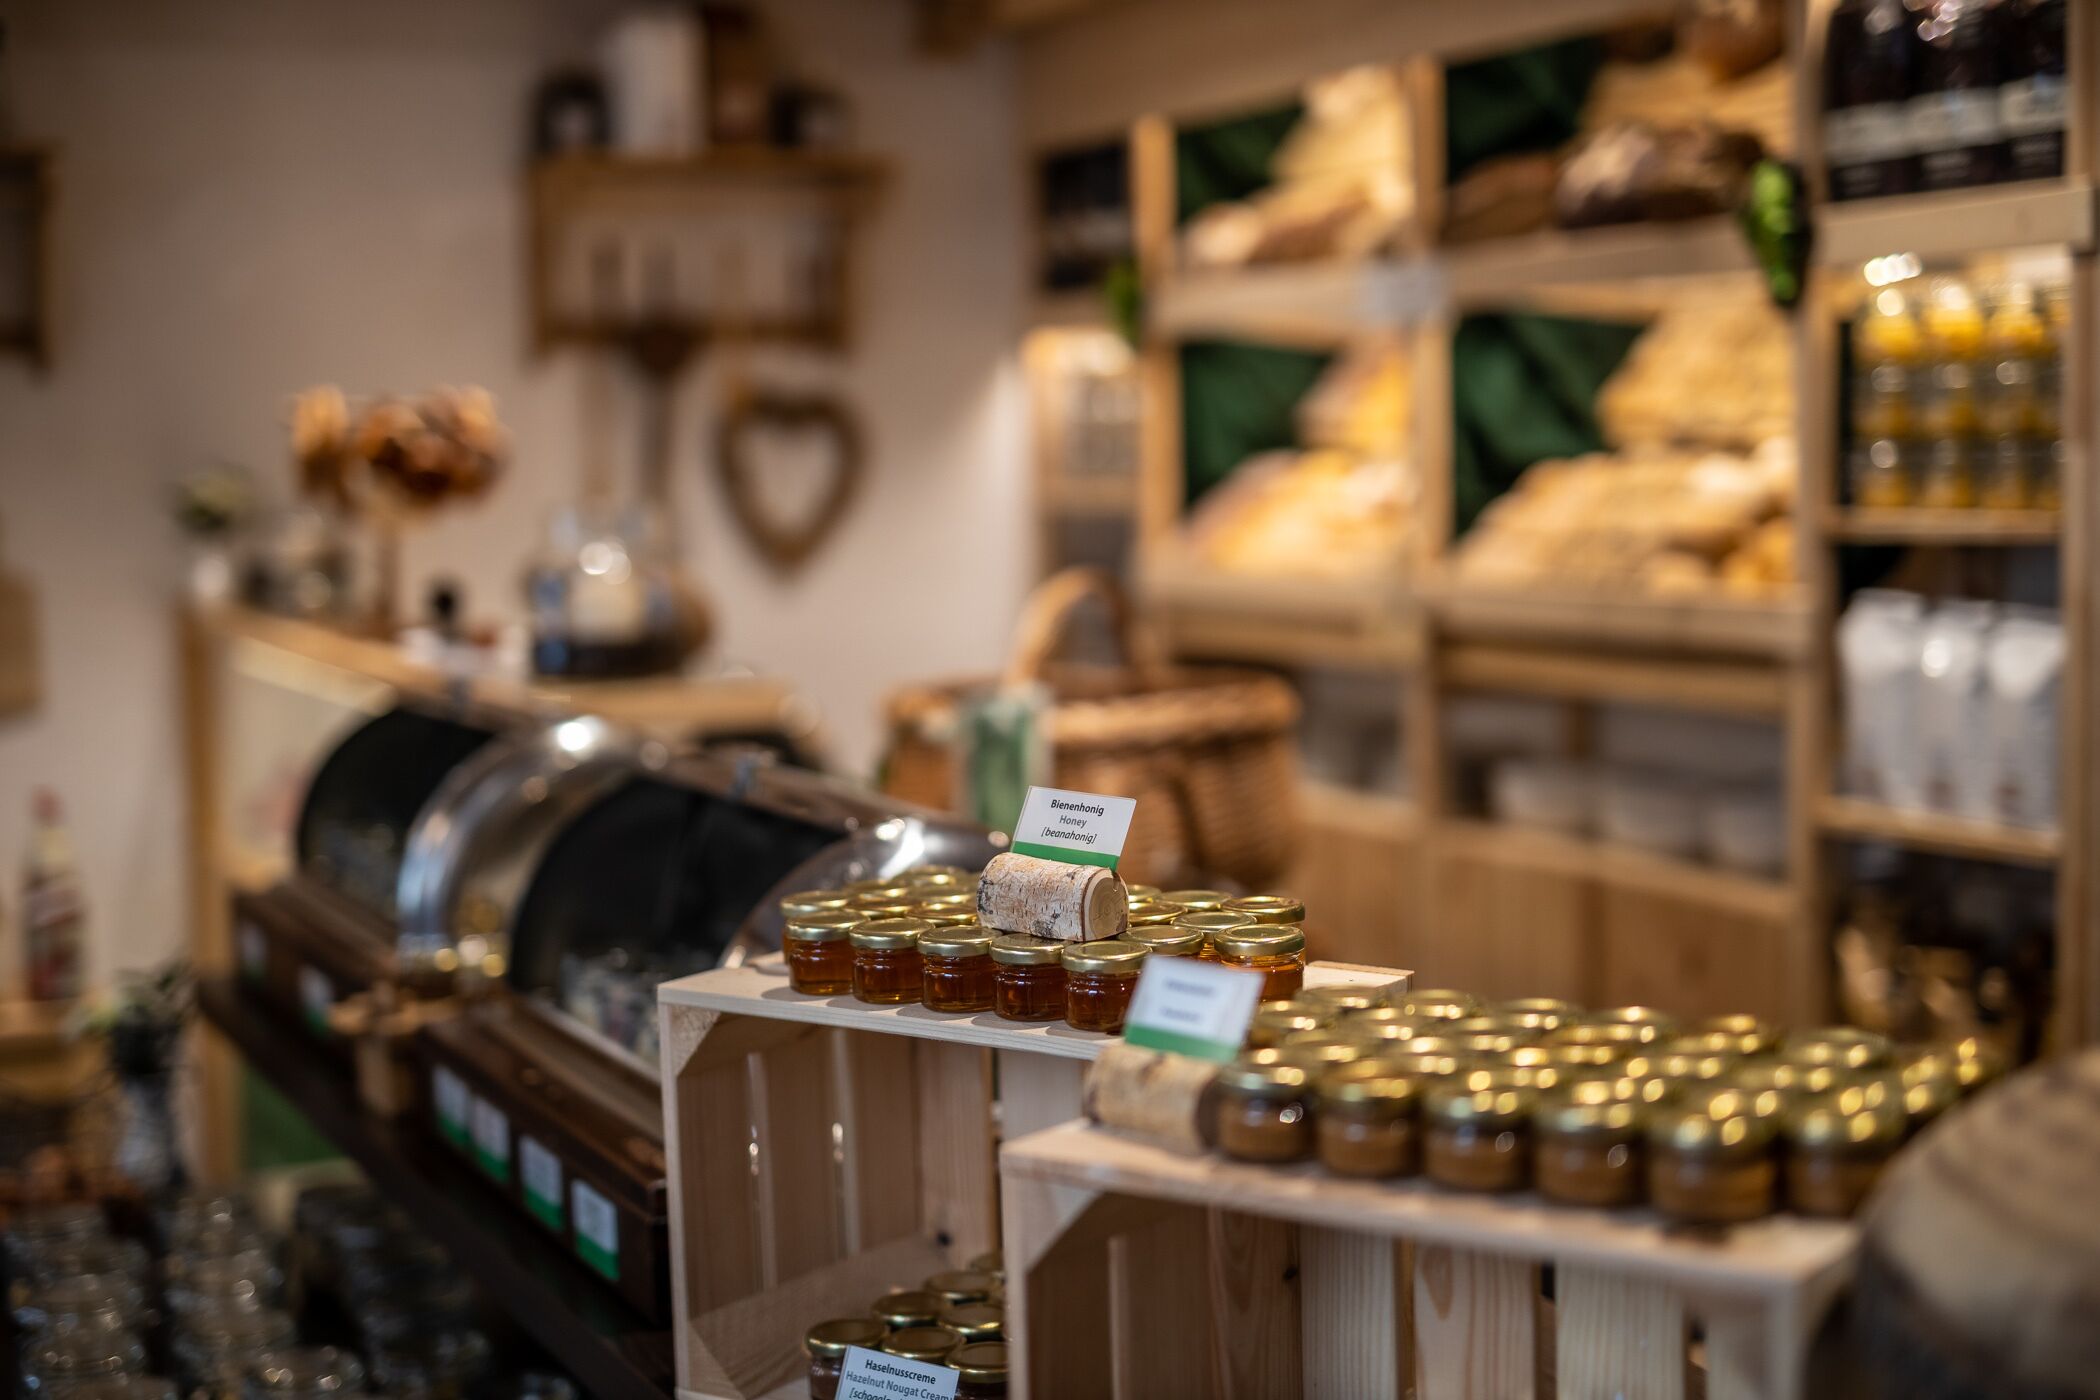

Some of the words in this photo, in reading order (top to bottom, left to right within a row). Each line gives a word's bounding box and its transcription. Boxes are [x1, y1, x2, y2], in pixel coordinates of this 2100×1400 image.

[1050, 799, 1105, 817] Bienenhonig
[1059, 814, 1088, 829] Honey
[1041, 826, 1098, 844] [beanahonig]
[865, 1359, 937, 1385] Haselnusscreme
[846, 1370, 885, 1389] Hazelnut
[886, 1380, 919, 1397] Nougat
[920, 1388, 953, 1400] Cream
